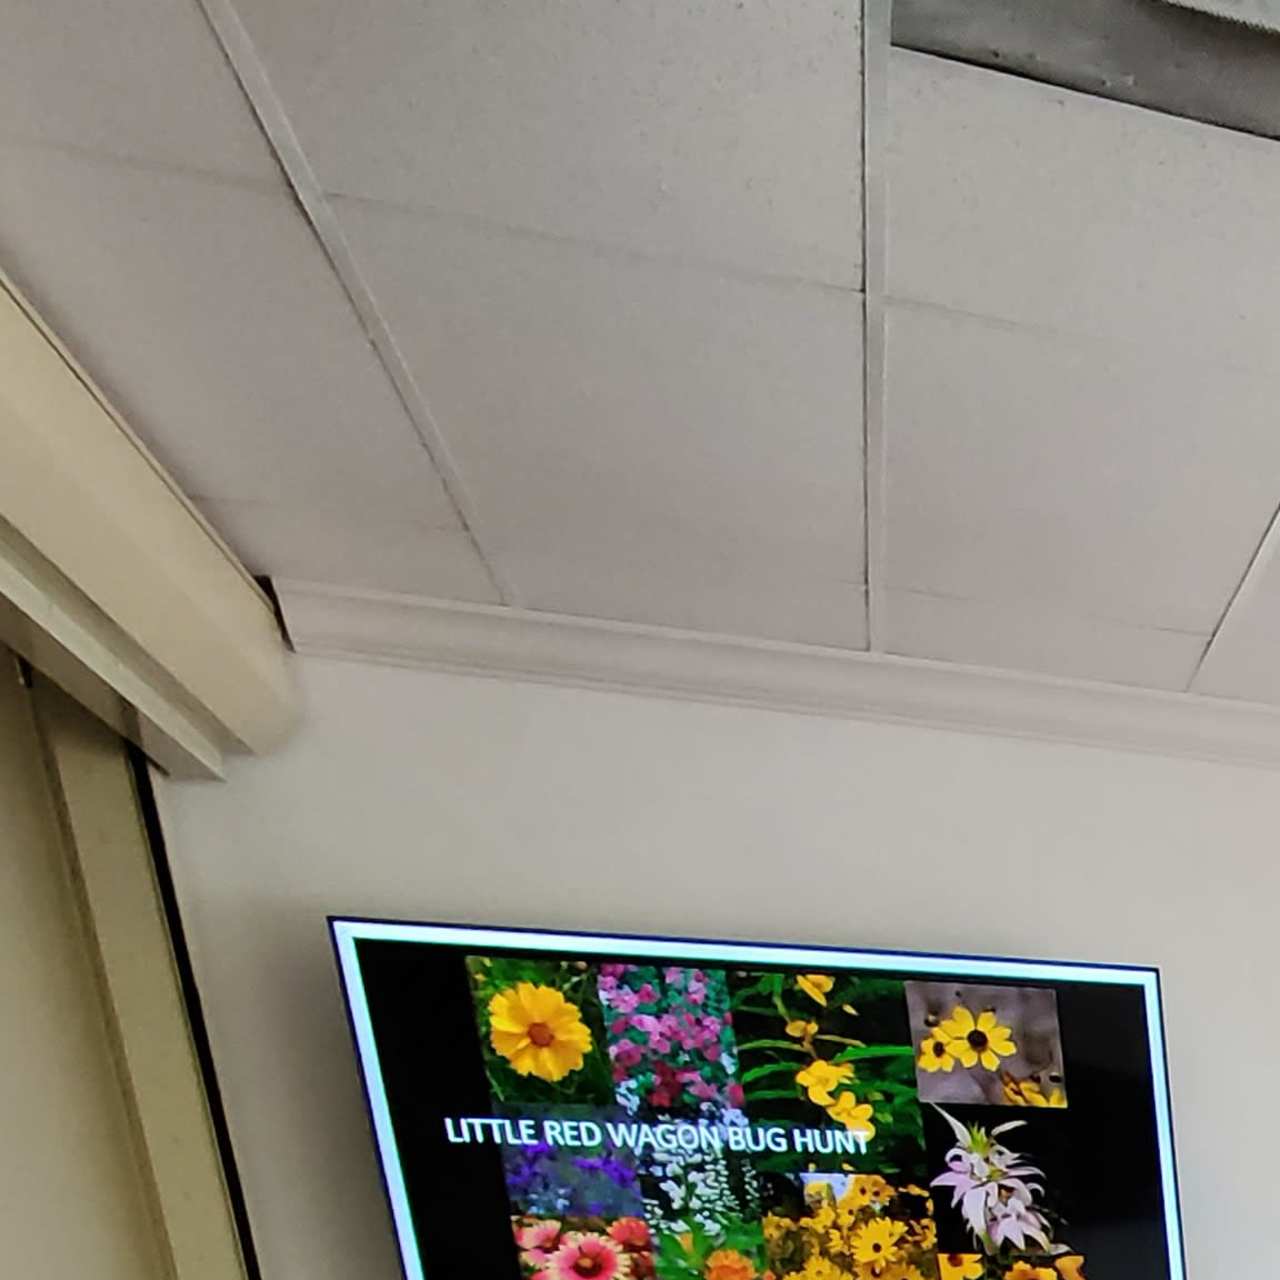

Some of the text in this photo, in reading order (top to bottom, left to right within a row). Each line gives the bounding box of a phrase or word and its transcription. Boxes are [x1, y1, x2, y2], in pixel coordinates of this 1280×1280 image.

[444, 1117, 870, 1155] LITTLE RED WAGON BUG HUNT
